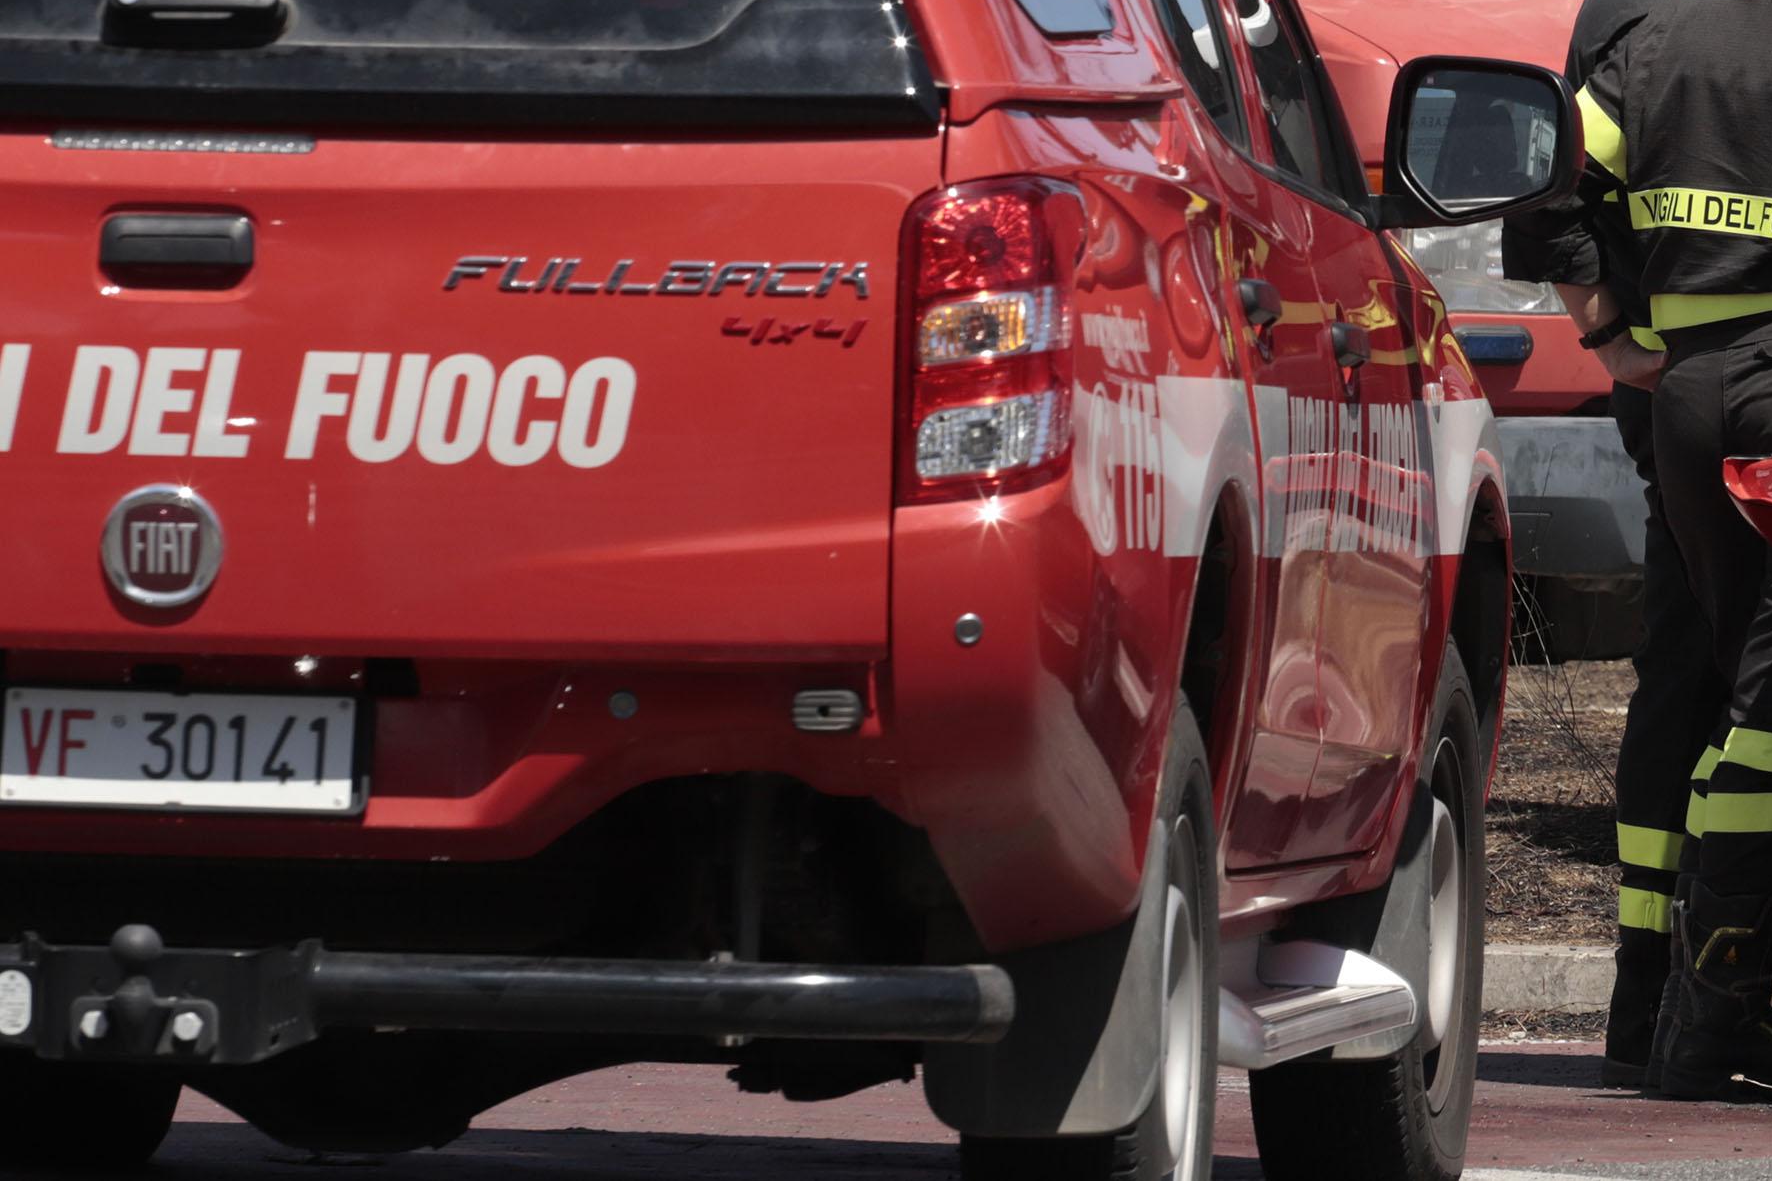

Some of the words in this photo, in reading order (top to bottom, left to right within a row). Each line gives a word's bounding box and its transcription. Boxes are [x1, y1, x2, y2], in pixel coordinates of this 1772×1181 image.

[1703, 195, 1755, 231] DEL
[443, 256, 869, 297] FULLBACK
[721, 317, 868, 348] 4x4
[57, 345, 257, 458] DEL
[285, 350, 637, 469] FUOCO
[130, 521, 199, 574] FIAT
[20, 706, 96, 778] VF
[139, 711, 329, 786] 30141
